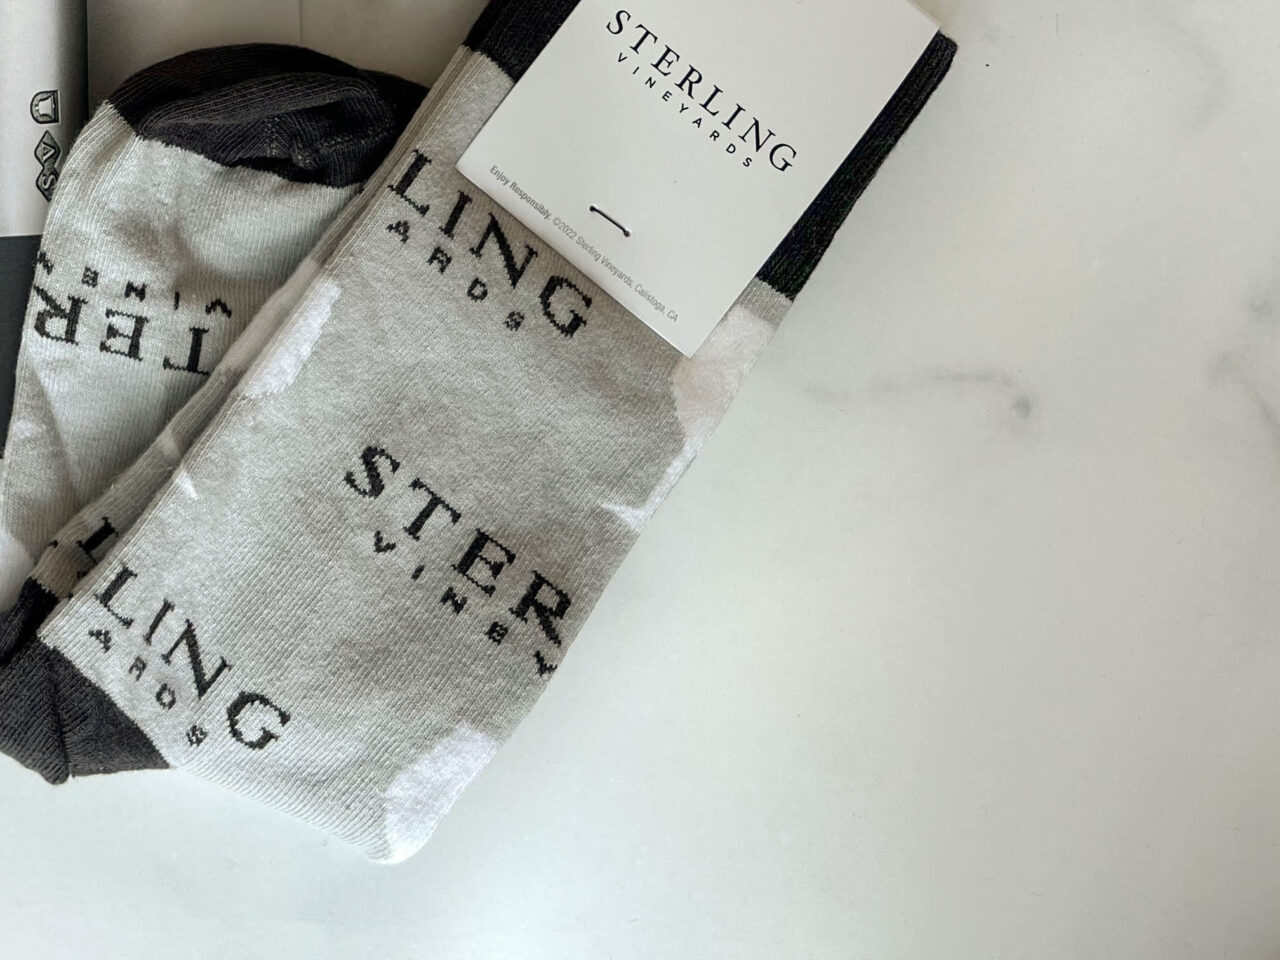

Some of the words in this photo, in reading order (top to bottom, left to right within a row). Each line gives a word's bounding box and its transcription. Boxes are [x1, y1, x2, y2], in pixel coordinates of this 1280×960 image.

[606, 9, 797, 172] STERLING
[617, 52, 753, 167] VINEYARDS
[387, 148, 592, 338] LING
[489, 165, 510, 186] Enjoy
[509, 180, 551, 221] Responsibly.
[552, 217, 577, 240] ©2022
[575, 236, 601, 262] Sterling
[600, 256, 634, 289] Vineyards,
[634, 283, 667, 314] Calistoga,
[667, 310, 679, 323] CA
[33, 284, 211, 376] TER
[343, 446, 572, 648] STER
[94, 562, 291, 751] LING
